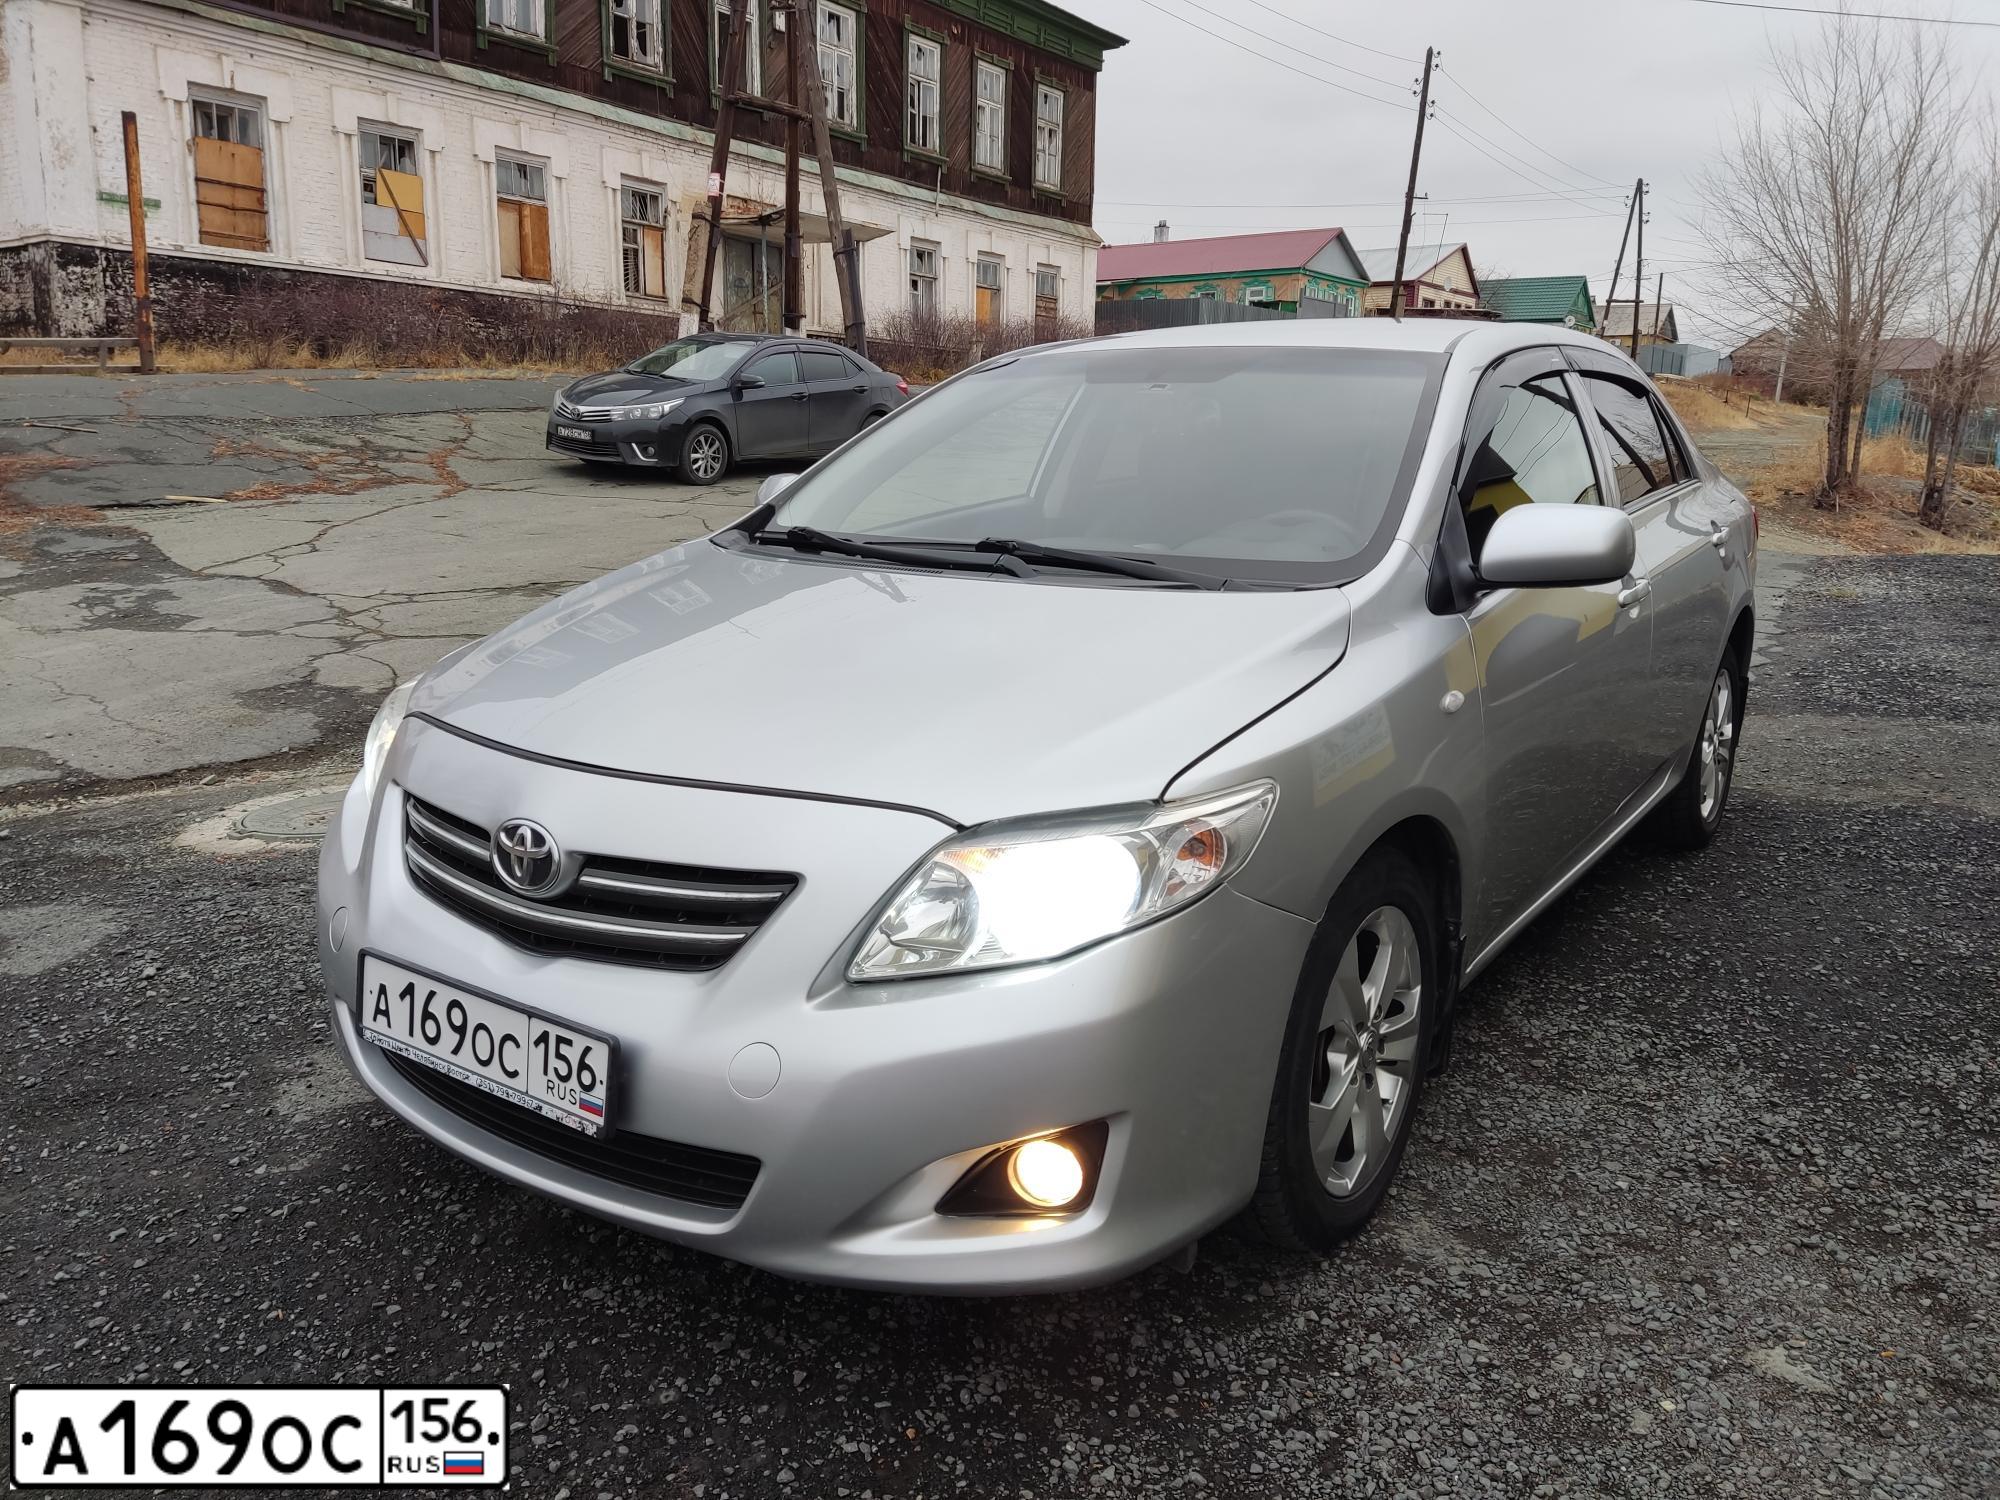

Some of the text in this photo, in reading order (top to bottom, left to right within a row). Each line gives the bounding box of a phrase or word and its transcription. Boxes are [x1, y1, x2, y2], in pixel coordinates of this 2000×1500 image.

[373, 981, 597, 1093] А169ОС 156
[546, 1079, 577, 1106] RUS
